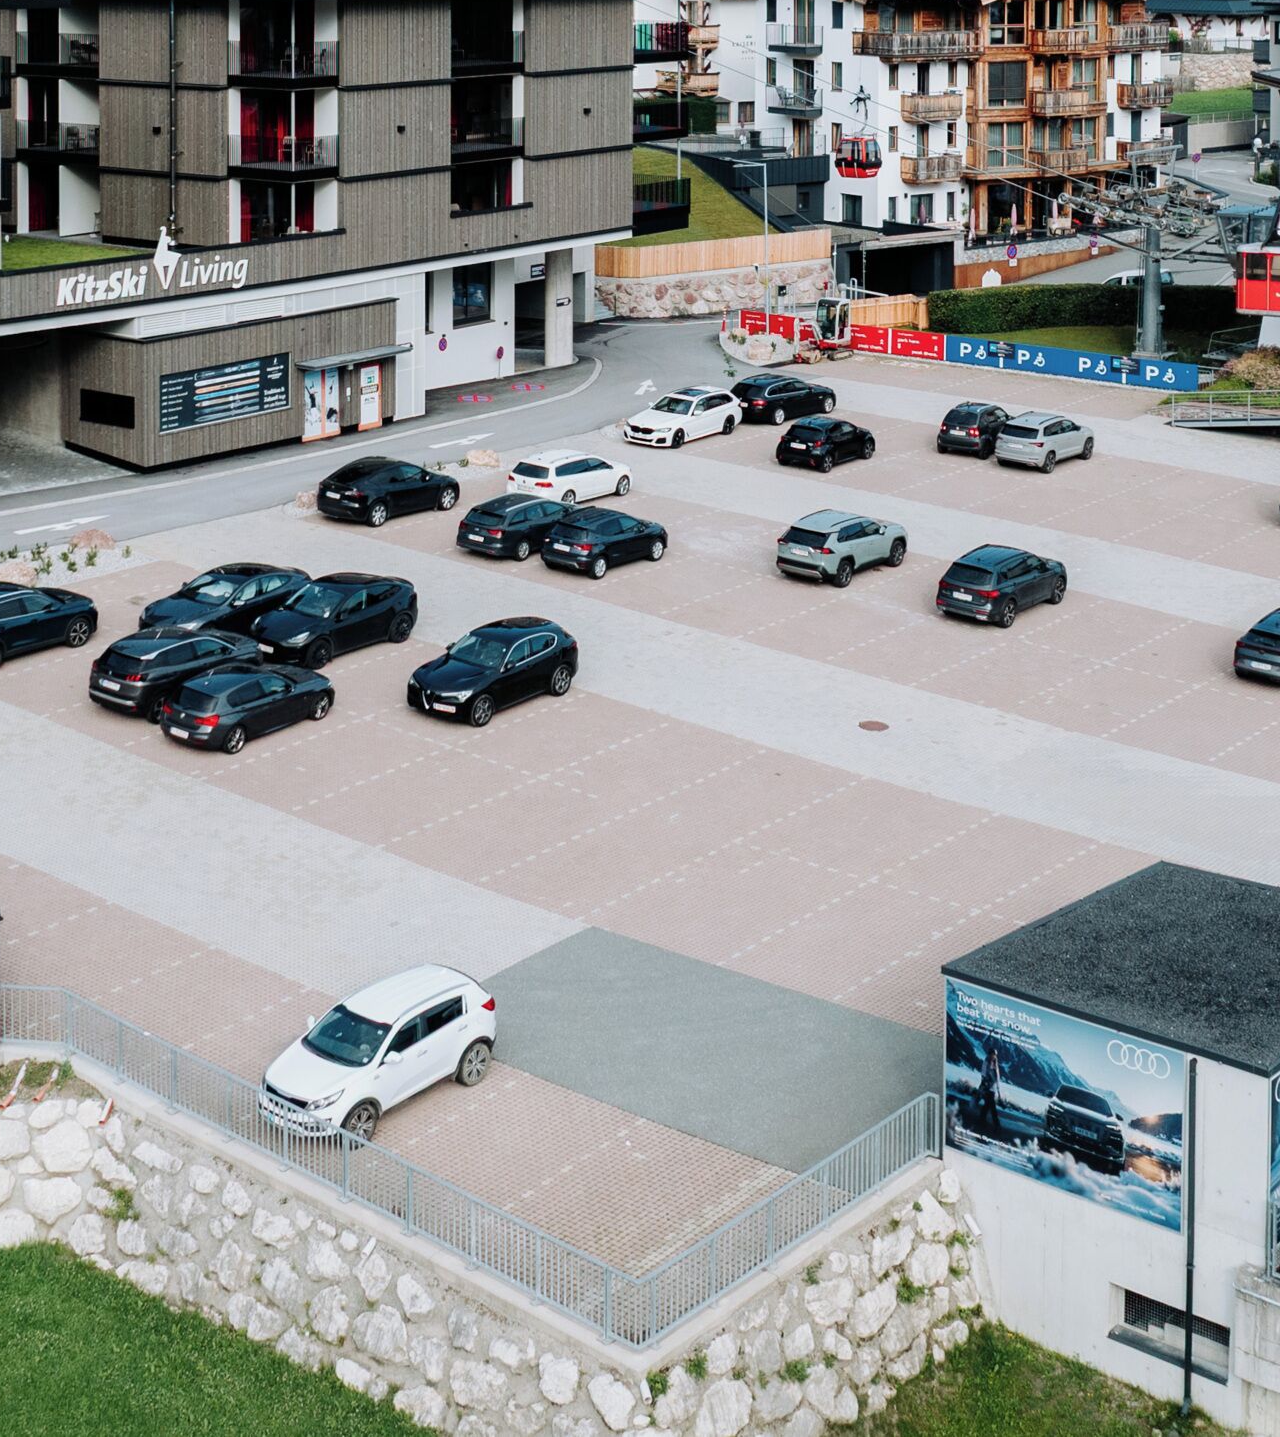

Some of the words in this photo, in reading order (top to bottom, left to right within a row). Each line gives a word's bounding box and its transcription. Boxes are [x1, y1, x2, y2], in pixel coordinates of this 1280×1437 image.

[56, 266, 149, 307] KitzSki
[179, 254, 249, 289] Living
[960, 342, 971, 357] P
[1018, 350, 1030, 364] P
[1079, 357, 1091, 372] P
[1146, 366, 1159, 381] P
[956, 991, 978, 1007] Two
[981, 999, 1015, 1018] hearts
[1018, 1012, 1041, 1027] that
[956, 1002, 980, 1018] beat
[983, 1011, 999, 1024] for
